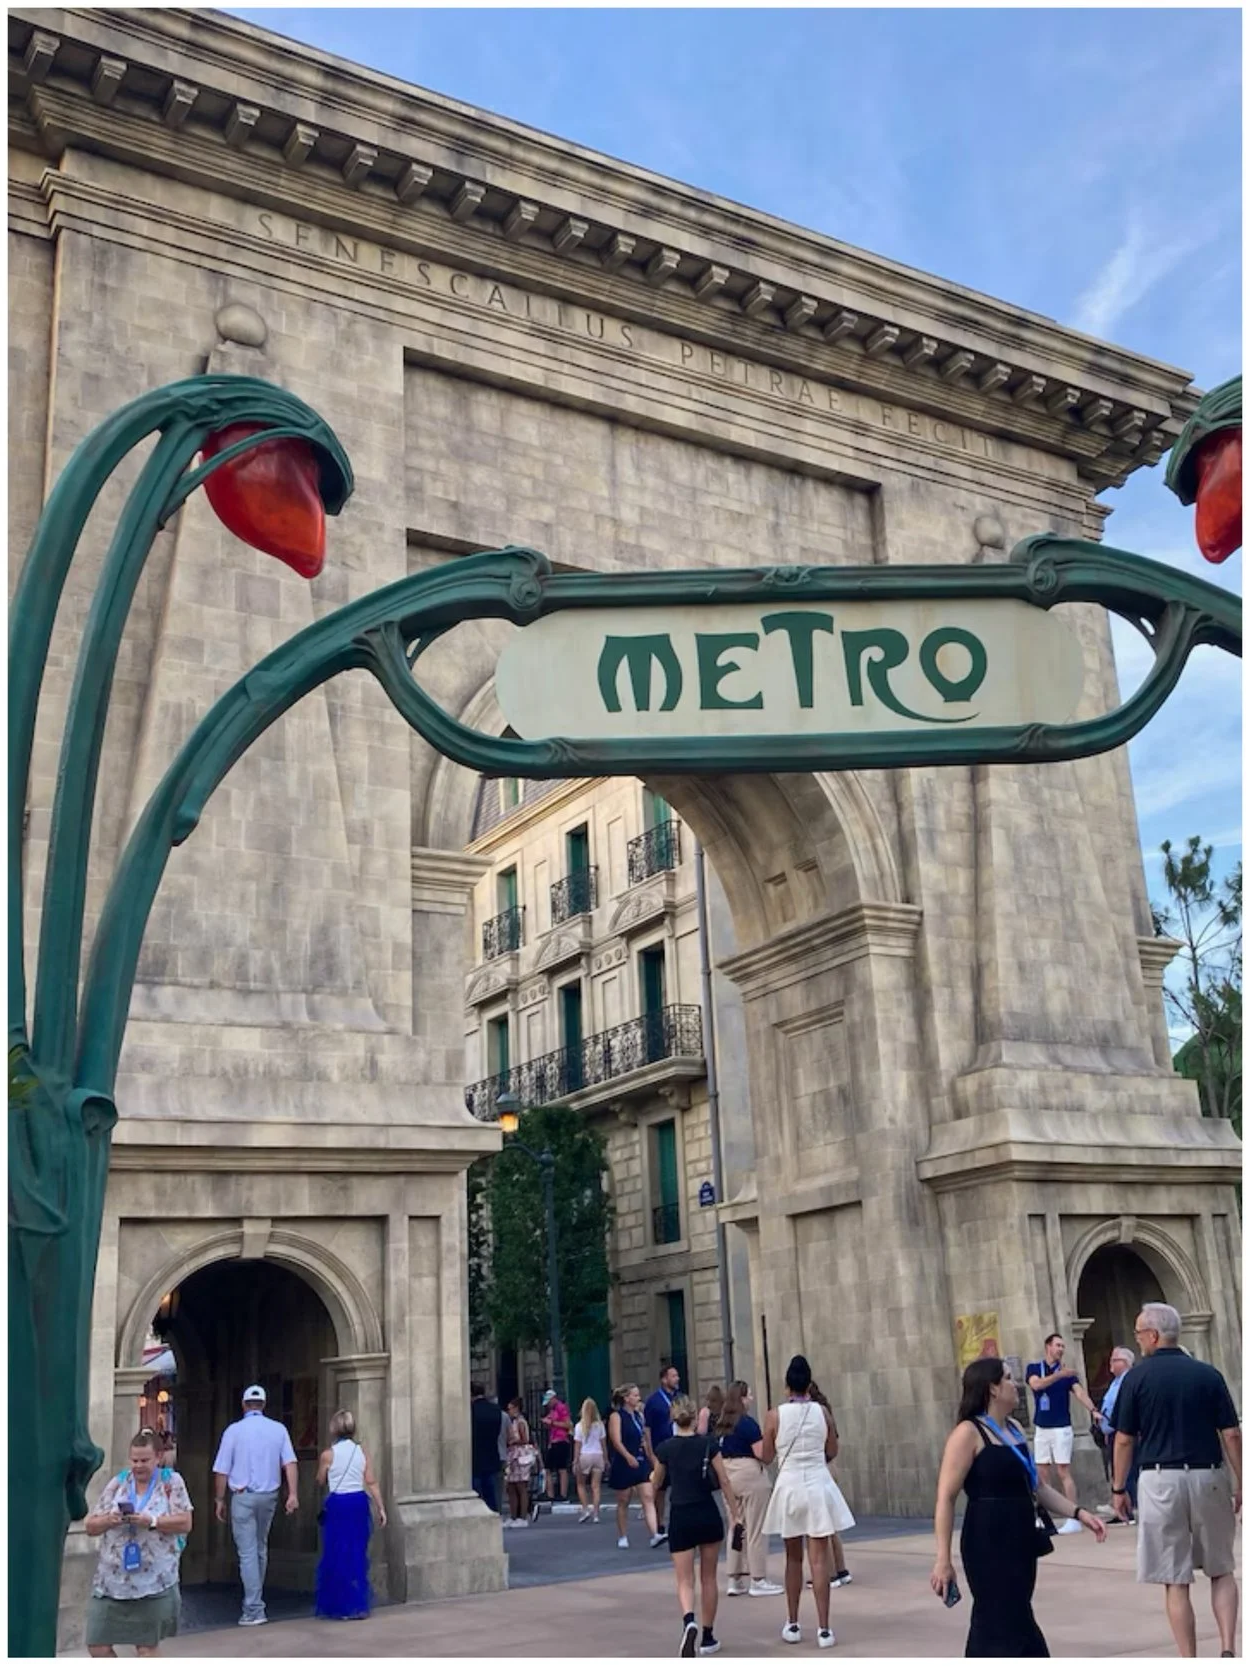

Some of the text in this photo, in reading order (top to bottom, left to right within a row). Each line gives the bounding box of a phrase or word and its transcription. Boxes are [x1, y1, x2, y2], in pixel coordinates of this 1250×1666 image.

[680, 342, 844, 412] PETRAE
[880, 404, 995, 457] FECIT
[596, 610, 989, 723] METRO
